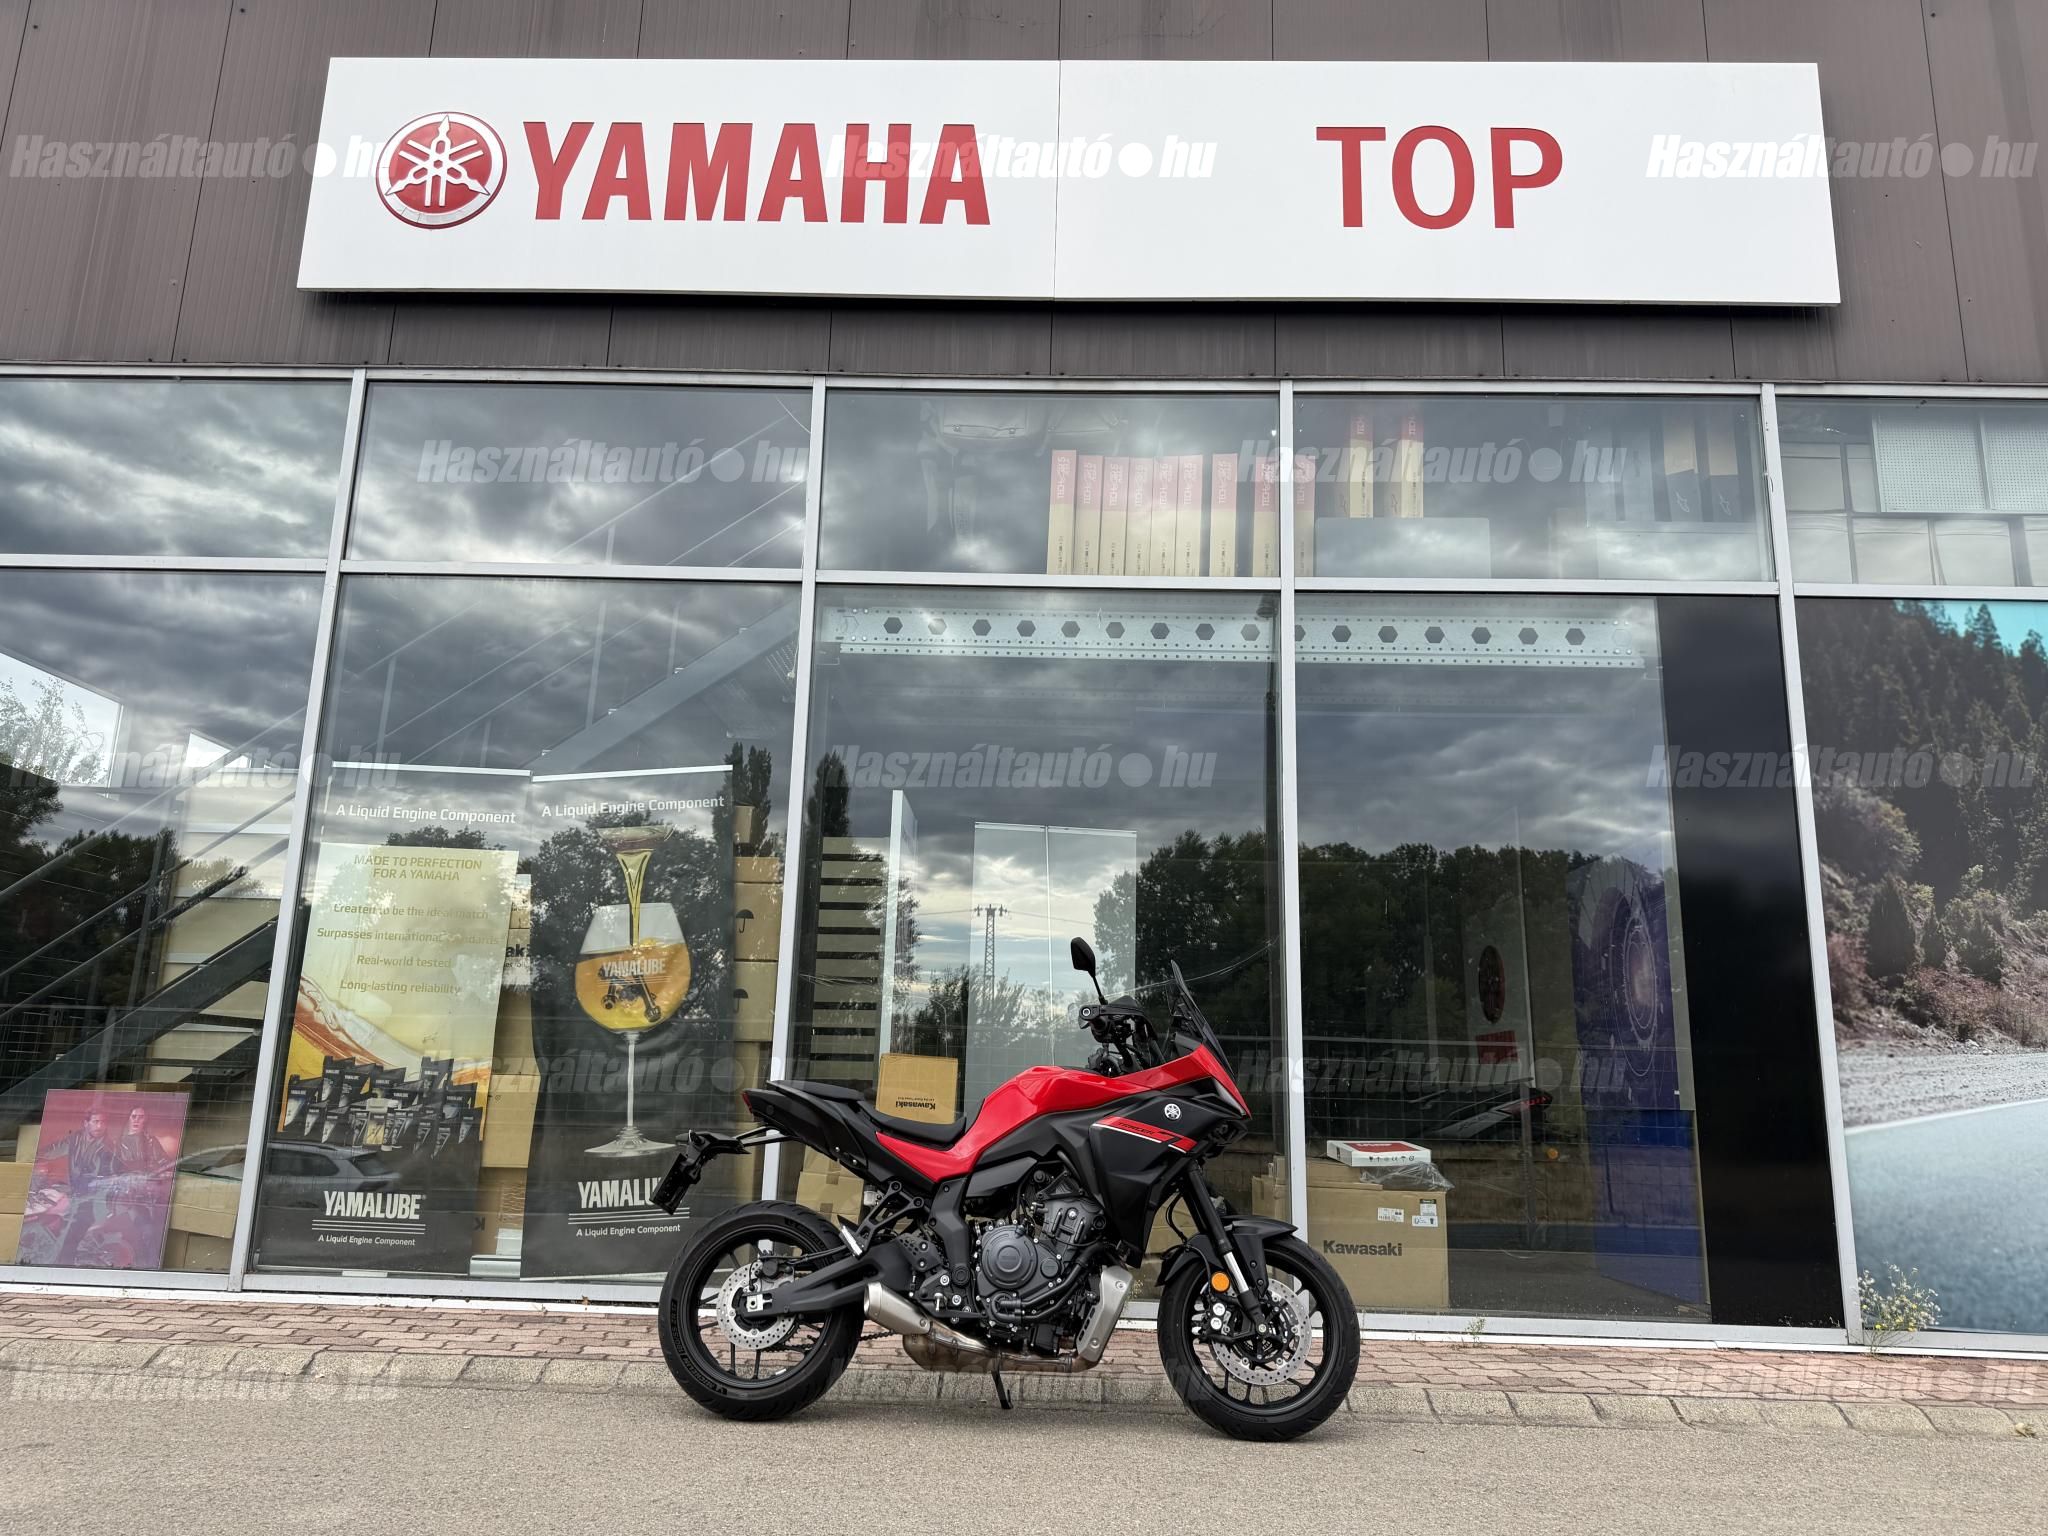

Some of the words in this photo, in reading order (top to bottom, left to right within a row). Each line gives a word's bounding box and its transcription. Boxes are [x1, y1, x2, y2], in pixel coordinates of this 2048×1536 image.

[523, 121, 990, 224] YAMAHA
[1316, 125, 1563, 230] TOP
[335, 804, 346, 816] A
[349, 805, 389, 820] Liquid
[393, 807, 437, 822] Engine
[440, 809, 517, 824] Component
[541, 806, 552, 817] A
[555, 803, 596, 818] Liquid
[600, 800, 645, 815] Engine
[648, 796, 725, 811] Component
[353, 855, 390, 866] MADE
[393, 857, 408, 867] TO
[409, 857, 483, 870] PERFECTION
[373, 868, 397, 879] FOR
[399, 869, 408, 879] A
[410, 870, 460, 881] YAMAHA
[392, 906, 405, 917] be
[407, 906, 425, 918] the
[317, 928, 372, 941] Surpasses
[374, 930, 444, 943] international
[356, 954, 414, 967] Real-world
[416, 956, 452, 968] tested
[602, 959, 668, 979] YAMALUBE
[340, 980, 408, 994] Long-lasting
[410, 983, 462, 995] reliability
[895, 1101, 936, 1110] Kawasaki
[578, 1177, 661, 1208] YAMALU
[324, 1191, 421, 1219] YAMALUBE
[585, 1227, 608, 1237] Liquid
[610, 1226, 635, 1236] Engine
[637, 1224, 680, 1235] Component
[327, 1235, 347, 1244] Liquid
[349, 1236, 372, 1245] Engine
[375, 1237, 416, 1246] Component
[1323, 1240, 1402, 1256] Kawasaki
